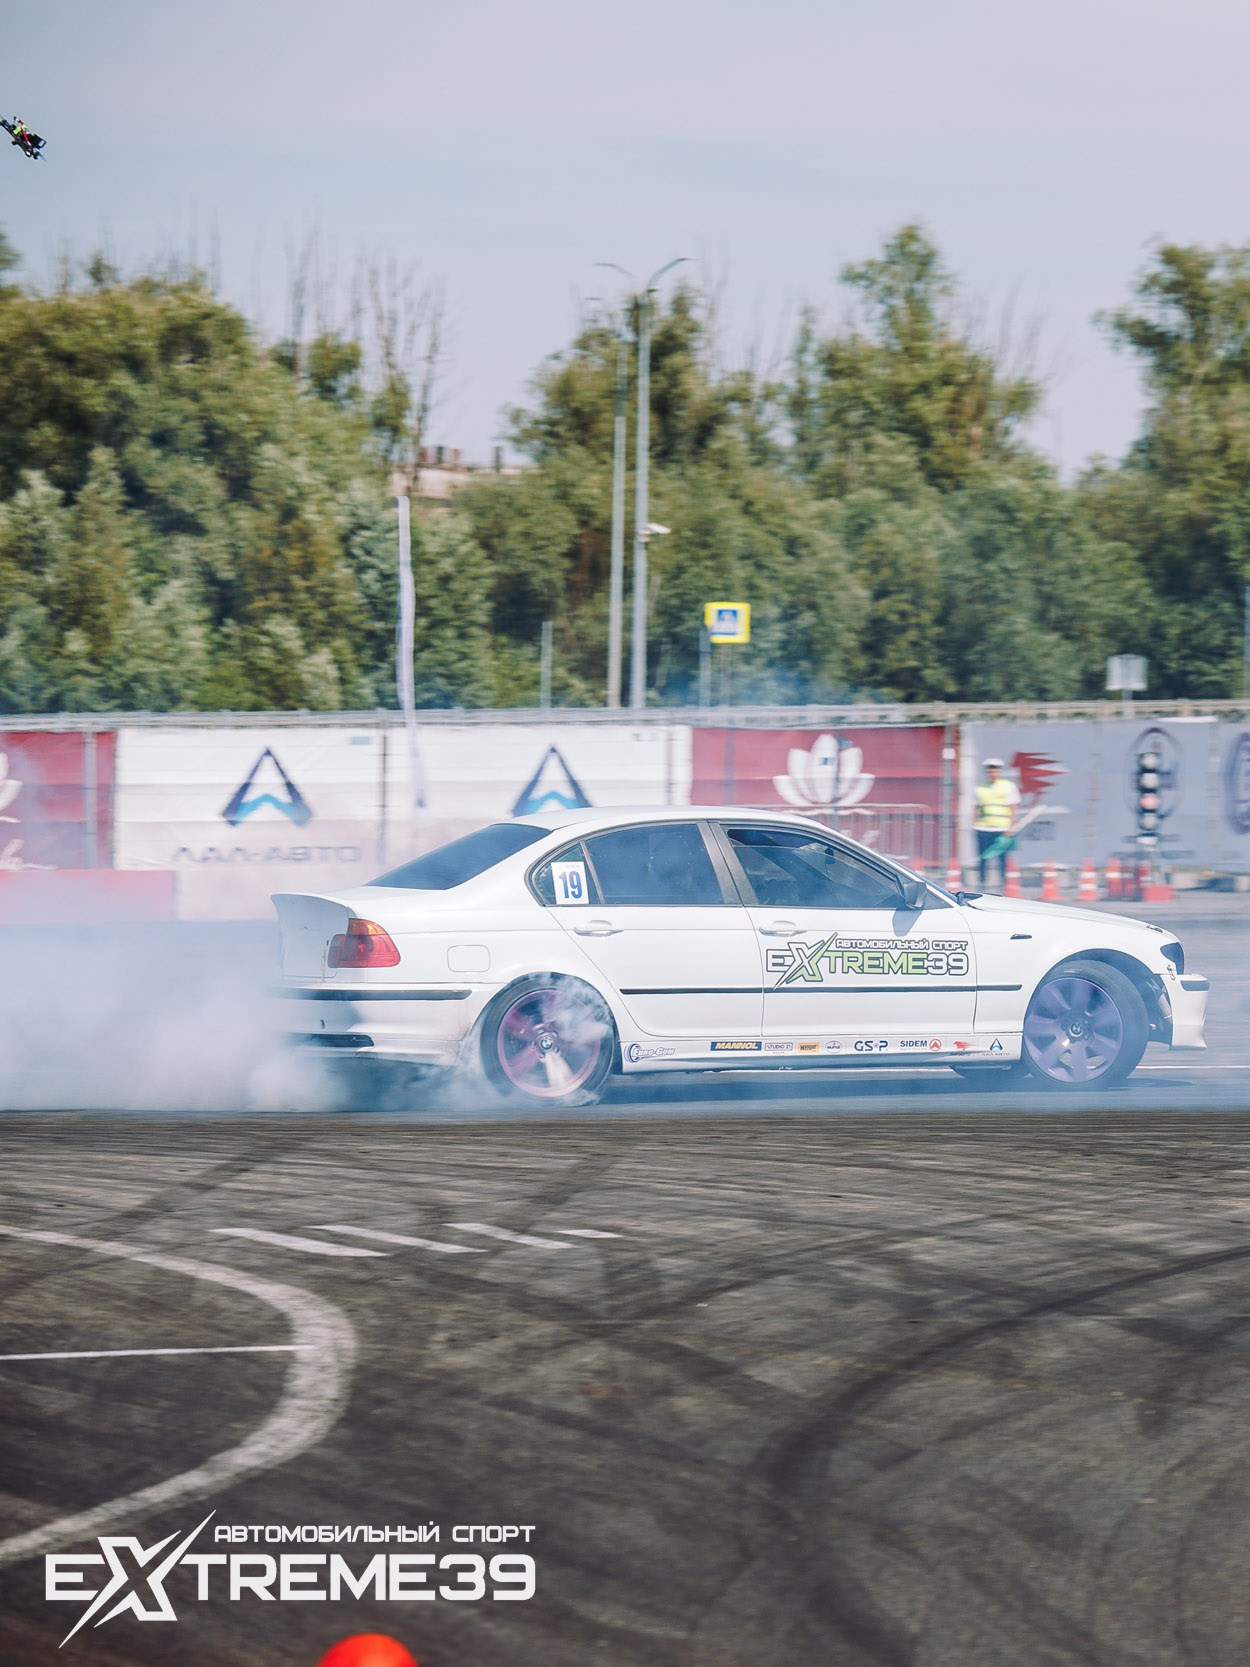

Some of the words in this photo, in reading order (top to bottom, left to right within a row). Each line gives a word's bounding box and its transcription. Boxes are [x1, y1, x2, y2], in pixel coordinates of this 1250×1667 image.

[558, 871, 583, 899] 19
[835, 938, 930, 950] АВТОМОБИЛЬНЫЙ
[932, 940, 968, 951] СПОРТ
[766, 932, 969, 990] EXTREME39
[715, 1042, 759, 1050] MANNOL
[900, 1040, 928, 1048] SIDEM
